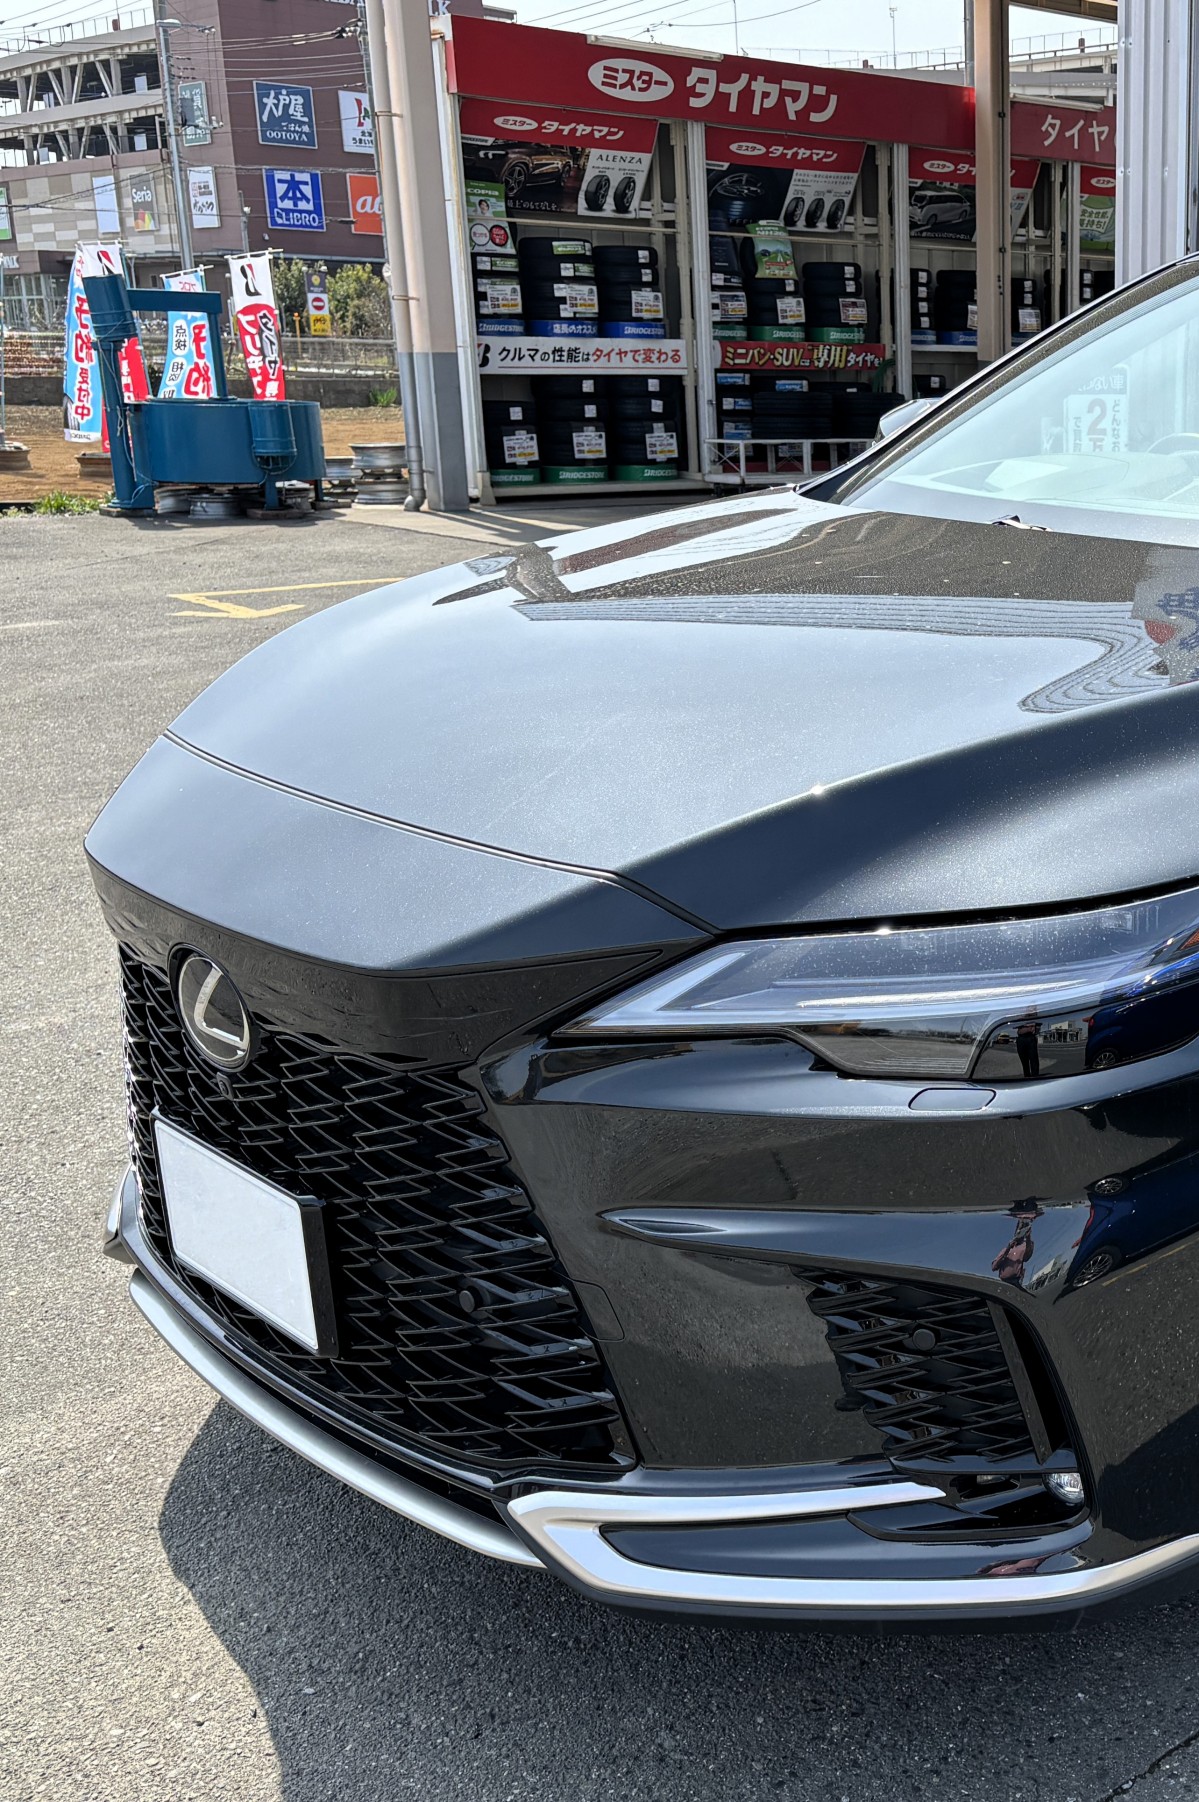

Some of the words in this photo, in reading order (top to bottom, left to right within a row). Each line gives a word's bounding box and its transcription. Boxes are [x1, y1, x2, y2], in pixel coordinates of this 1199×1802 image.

[601, 65, 668, 92] ミスター
[686, 66, 838, 123] タイヤマン
[262, 89, 309, 122] 大戸屋
[266, 130, 308, 142] OOTOYA
[501, 117, 533, 127] ミスター
[541, 120, 624, 140] タイヤマン
[1041, 114, 1116, 152] タイヤ
[596, 154, 643, 165] ALENZA
[735, 143, 765, 153] ミスター
[768, 145, 838, 163] タイヤマン
[131, 186, 152, 203] Seria
[277, 173, 311, 208] 本
[282, 211, 319, 226] LIBRO
[497, 346, 682, 364] クルマの性能はタイヤで変わる
